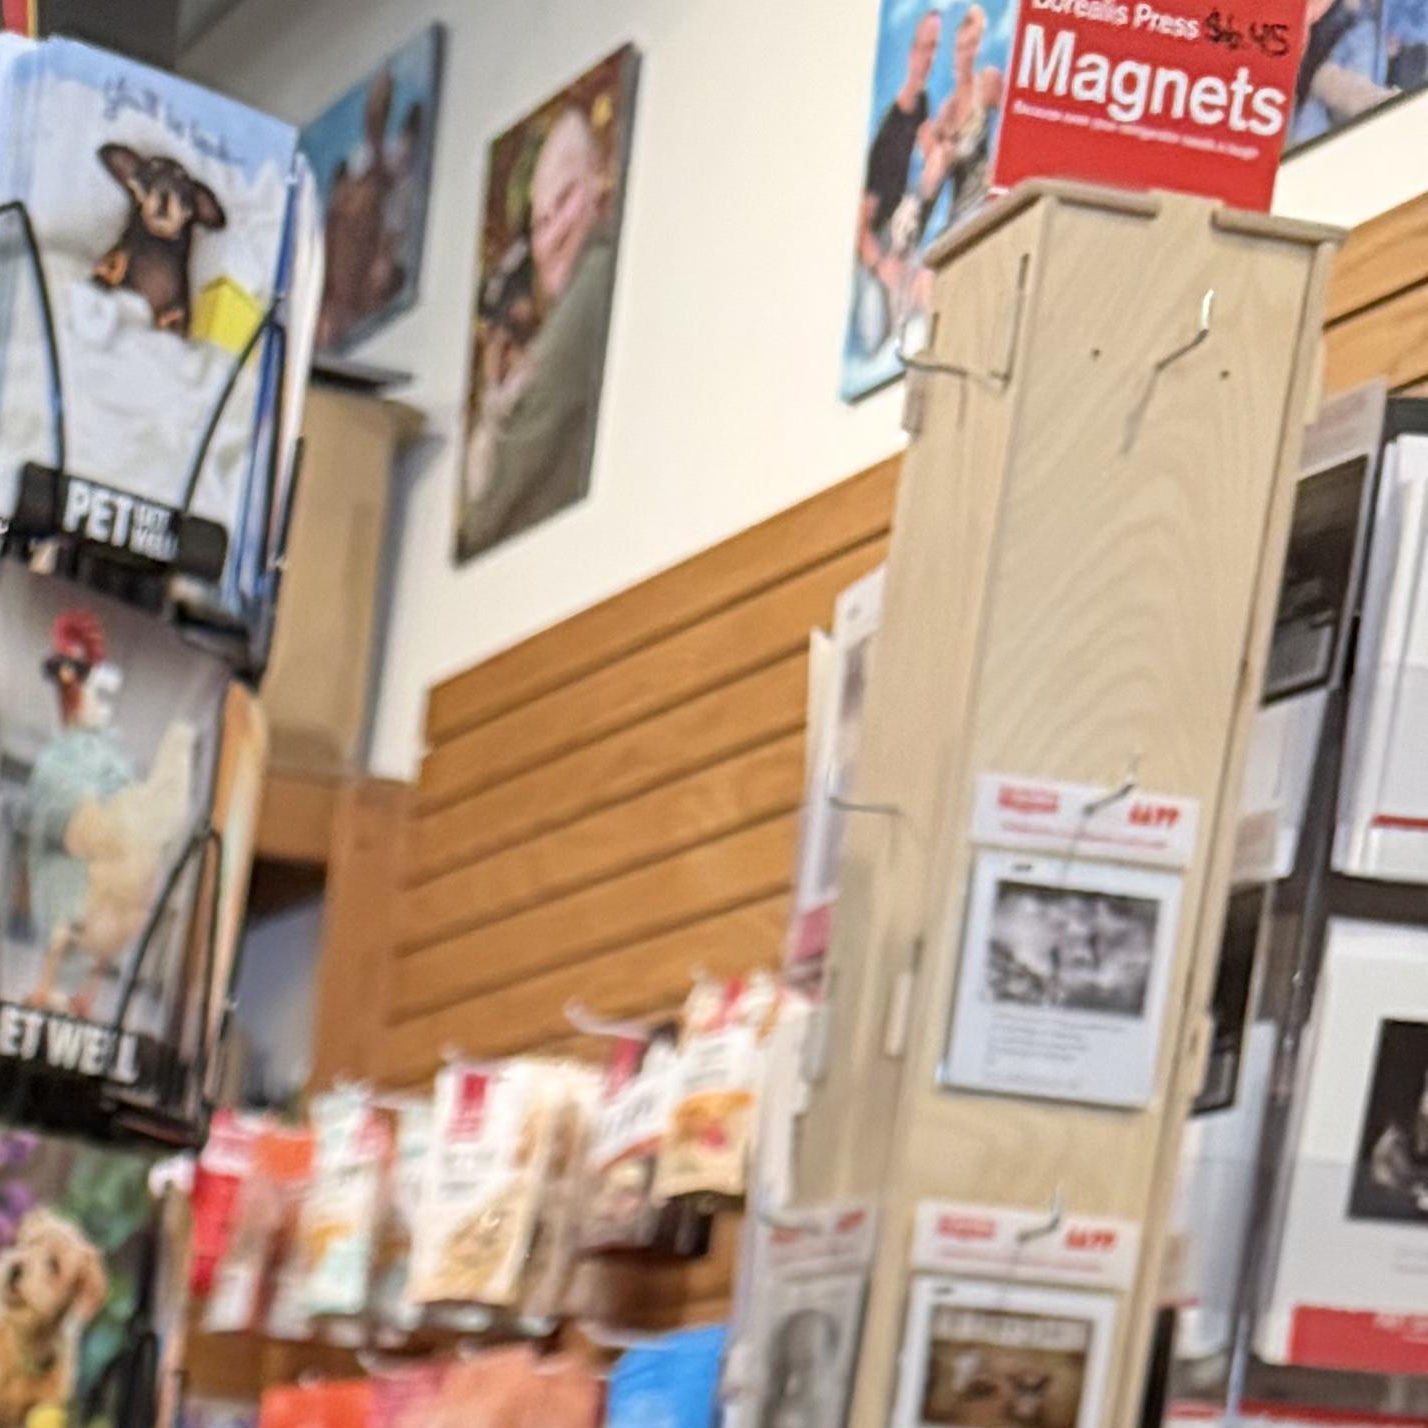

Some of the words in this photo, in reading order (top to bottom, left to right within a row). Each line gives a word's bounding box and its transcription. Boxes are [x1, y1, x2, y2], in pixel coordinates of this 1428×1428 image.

[1132, 3, 1200, 40] Press
[1017, 23, 1287, 137] Magnets
[62, 478, 134, 548] PET
